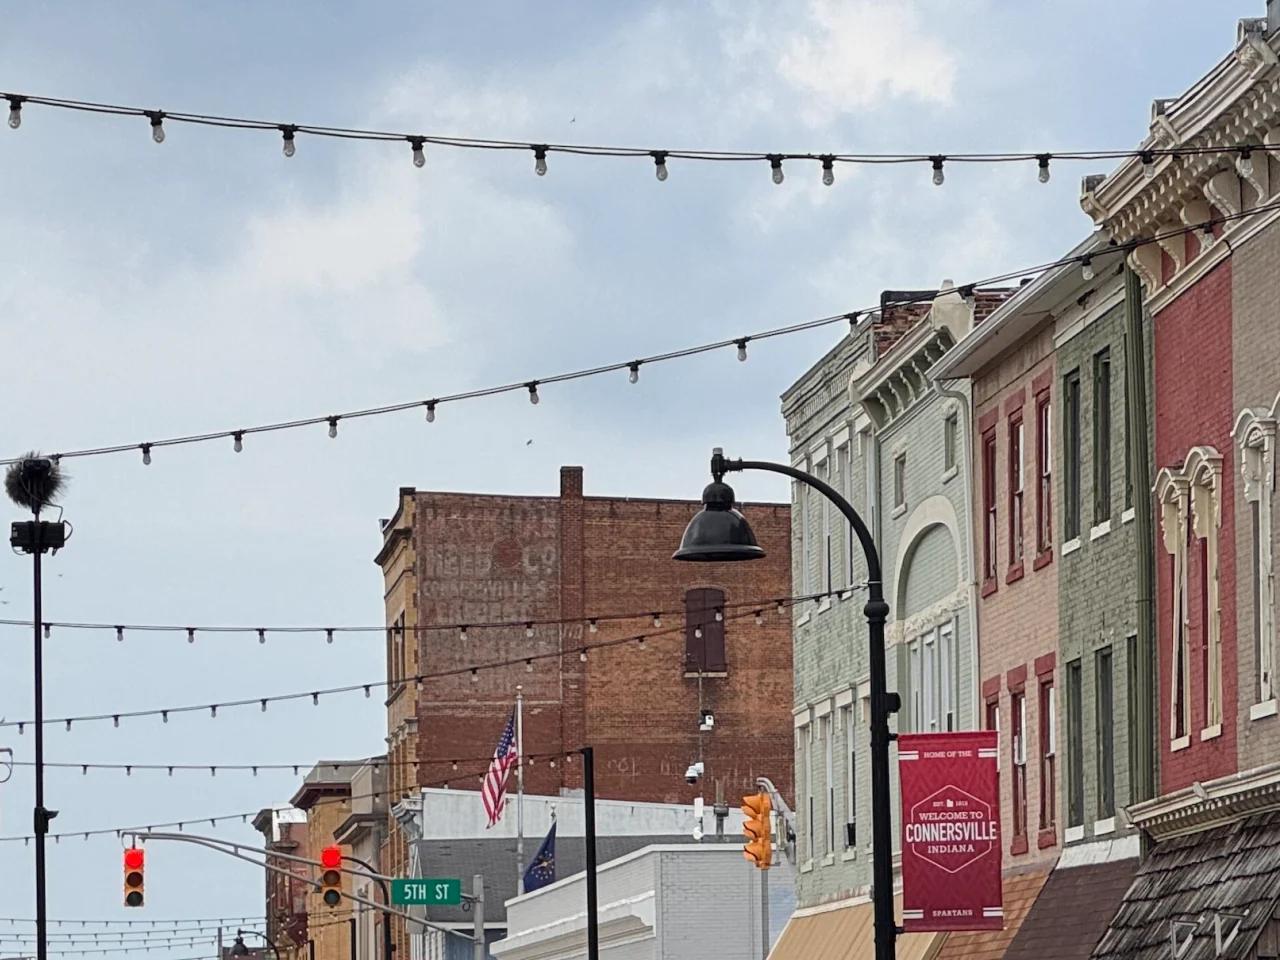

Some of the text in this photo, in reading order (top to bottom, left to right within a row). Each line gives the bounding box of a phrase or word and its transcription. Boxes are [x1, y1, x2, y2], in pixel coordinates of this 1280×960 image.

[923, 750, 946, 759] HOME
[946, 750, 957, 758] OF
[918, 811, 984, 821] WELCOME TO
[905, 821, 998, 843] CONNERSVILLE
[927, 844, 975, 854] INDIANA
[404, 884, 450, 900] 5TH ST
[932, 909, 973, 918] SPARTANS
